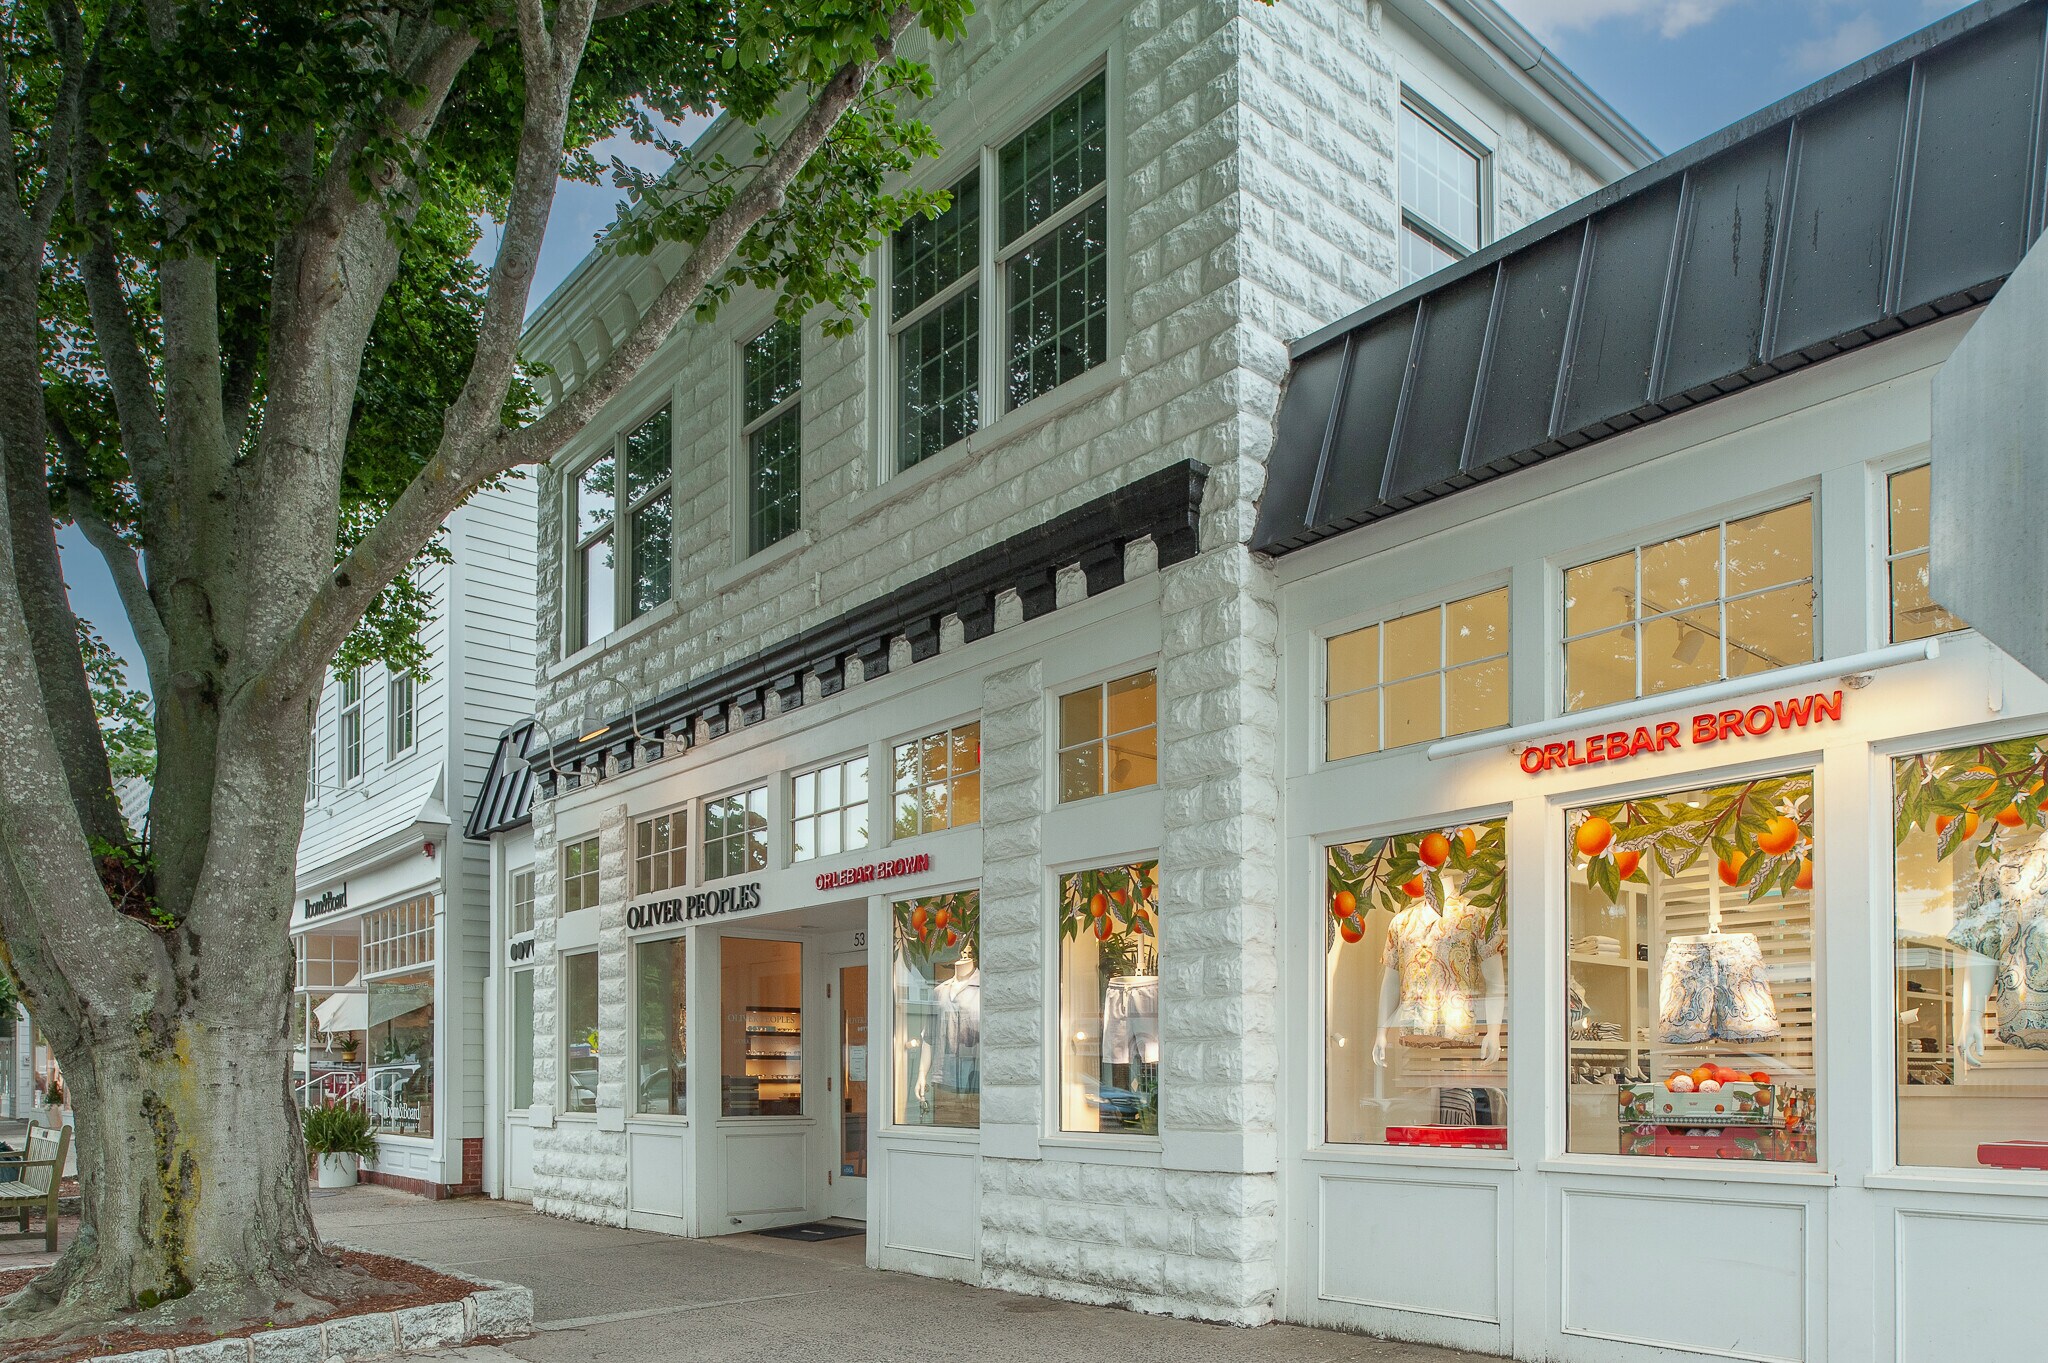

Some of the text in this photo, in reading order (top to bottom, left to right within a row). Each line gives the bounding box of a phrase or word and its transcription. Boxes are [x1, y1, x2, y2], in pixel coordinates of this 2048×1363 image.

[1519, 690, 1844, 774] ORLEBAR BROWN
[815, 853, 930, 891] ORLEBAR BROWN
[626, 882, 761, 930] OLIVER PEOPLES
[853, 932, 866, 947] 53
